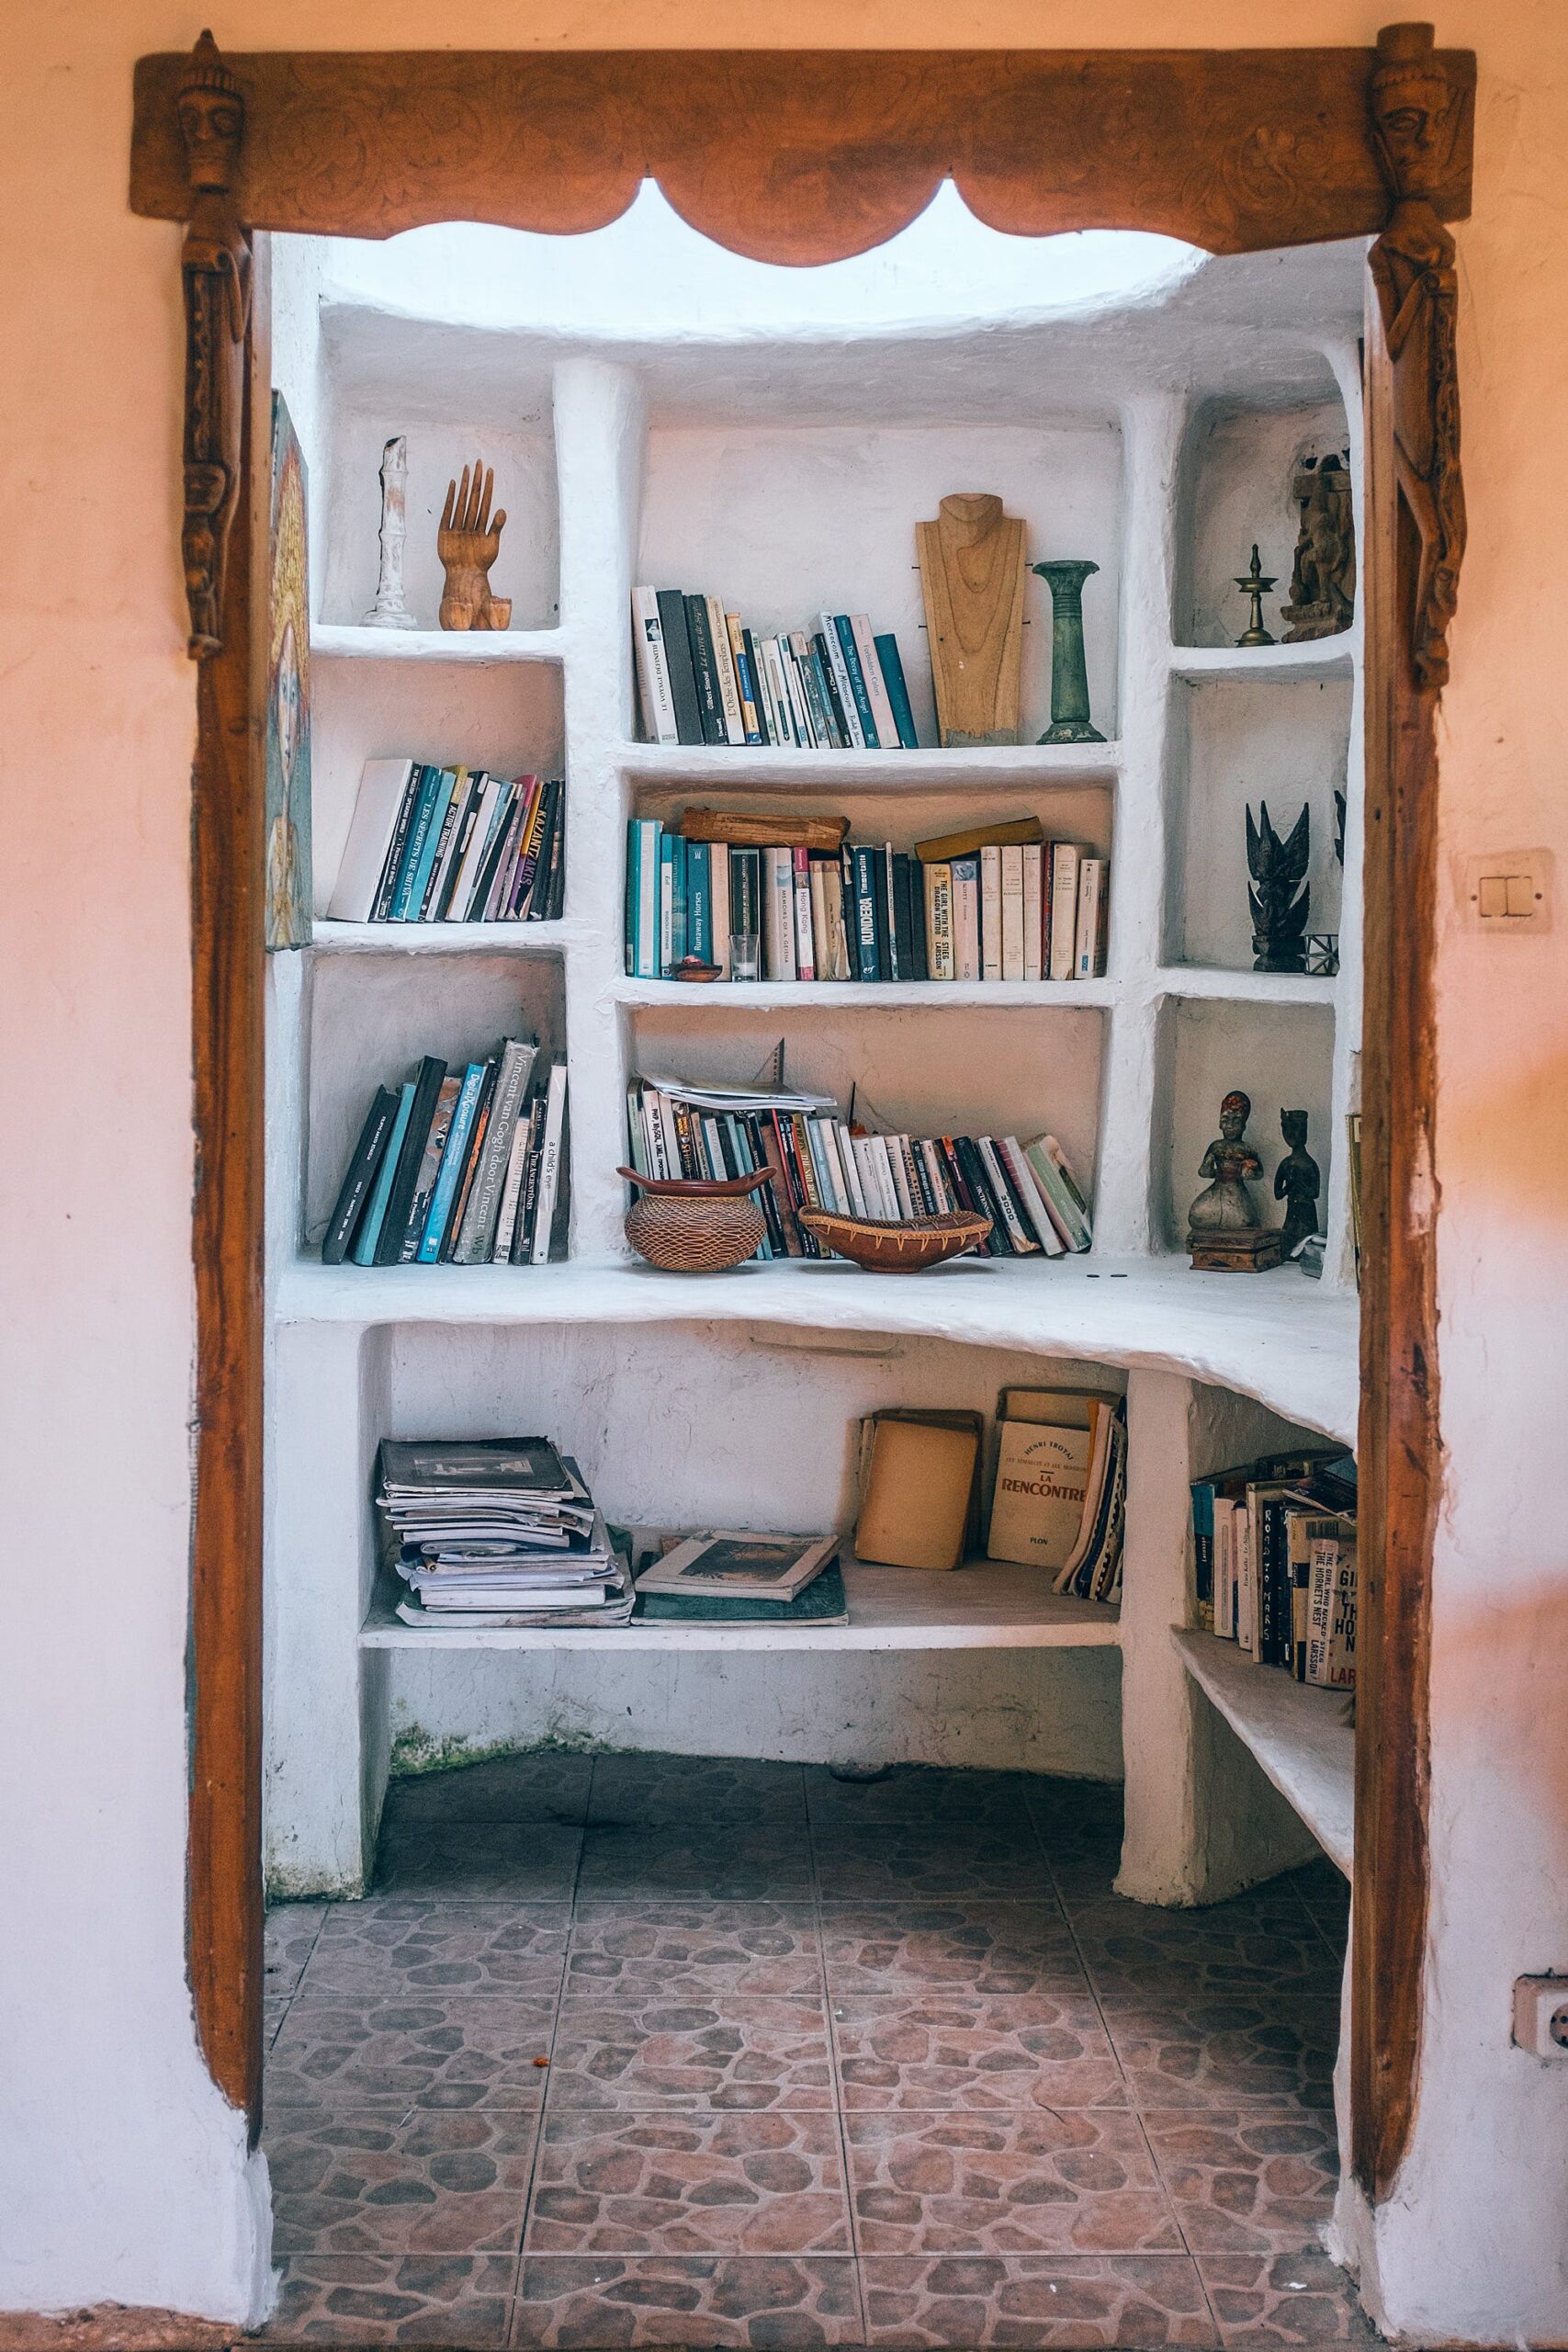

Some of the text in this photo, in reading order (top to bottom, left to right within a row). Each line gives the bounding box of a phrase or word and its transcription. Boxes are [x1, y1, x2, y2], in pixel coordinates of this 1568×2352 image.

[694, 626, 702, 634] de
[696, 637, 705, 655] Livre
[846, 645, 854, 655] The
[700, 657, 707, 666] Le
[717, 642, 729, 673] Templiers
[823, 614, 840, 659] Macrocosm
[838, 673, 852, 707] Microcosm
[848, 657, 859, 675] Decay
[826, 666, 836, 685] Cheval
[853, 675, 861, 684] of
[863, 644, 881, 696] Forbidden Colors
[657, 675, 665, 701] VOYAGE
[705, 691, 714, 709] Gilbert
[725, 687, 736, 716] L'Ordre
[857, 695, 868, 714] Angel
[444, 805, 457, 826] ACTOR
[401, 803, 431, 896] LES SECRETS DE SHIVA
[434, 827, 451, 858] TRAINING
[521, 808, 547, 886] KAZANTZAKIS
[799, 891, 807, 911] Hong
[859, 897, 874, 944] KUNDERA
[694, 918, 703, 950] Runaway
[649, 1108, 659, 1122] PHP,
[475, 1052, 525, 1229] Vincent van Gogh door Vincent
[651, 1123, 660, 1142] MySQL,
[546, 1148, 556, 1172] child's
[801, 1154, 809, 1167] THE
[901, 1149, 913, 1190] BANGKOK
[525, 1153, 538, 1209] THE ANCIENT ONES
[1024, 1442, 1074, 1461] HENRI TROYAT
[1040, 1475, 1052, 1483] LA
[1001, 1478, 1087, 1502] RENCONTRE
[1030, 1537, 1048, 1545] PLON
[1264, 1564, 1270, 1582] TO
[1312, 1552, 1325, 1625] THE HORNET'S NEST
[1309, 1639, 1319, 1674] LARSSON
